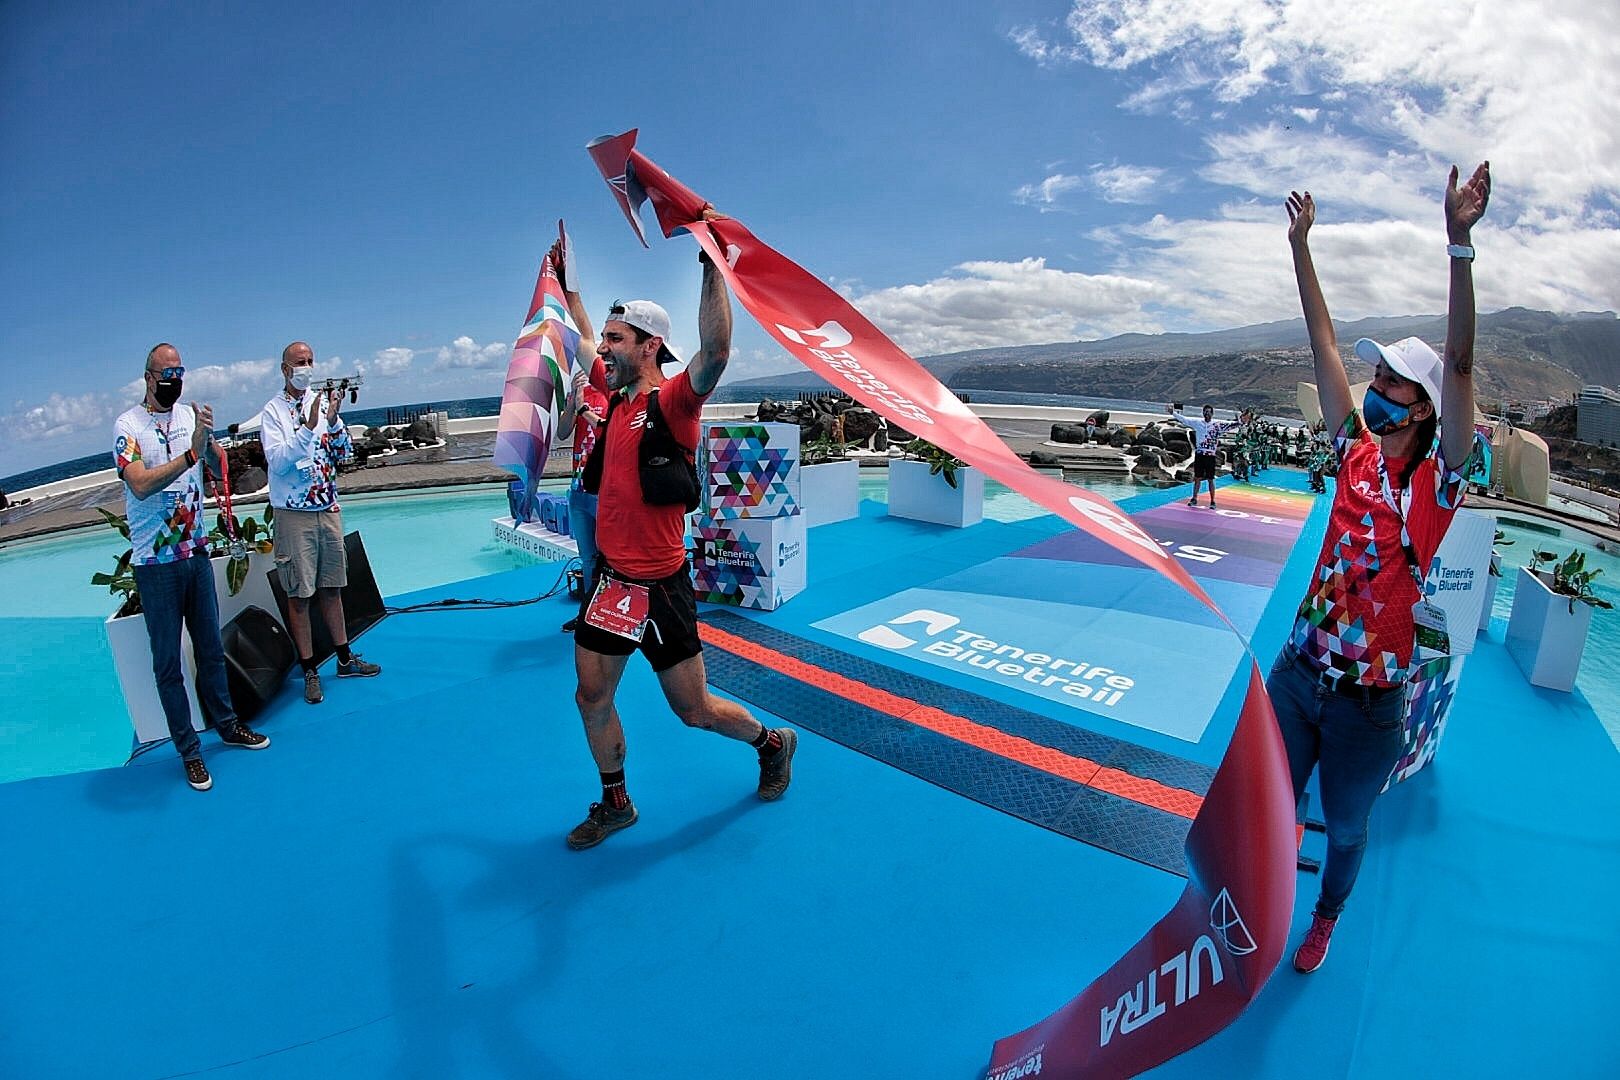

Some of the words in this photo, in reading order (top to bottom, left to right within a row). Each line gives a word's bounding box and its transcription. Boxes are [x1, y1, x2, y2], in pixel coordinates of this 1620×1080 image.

[833, 350, 934, 425] Tenerife
[494, 526, 530, 552] despierta
[533, 542, 572, 562] emocio
[717, 549, 755, 560] Tenerife
[717, 557, 755, 568] Bluetrail
[1441, 567, 1474, 579] Tenerife
[1438, 580, 1472, 591] Bluetrail
[616, 595, 631, 614] 4
[951, 629, 1135, 690] Tenerife
[923, 640, 1125, 707] Bluetrail
[1100, 934, 1224, 1047] ULTRA
